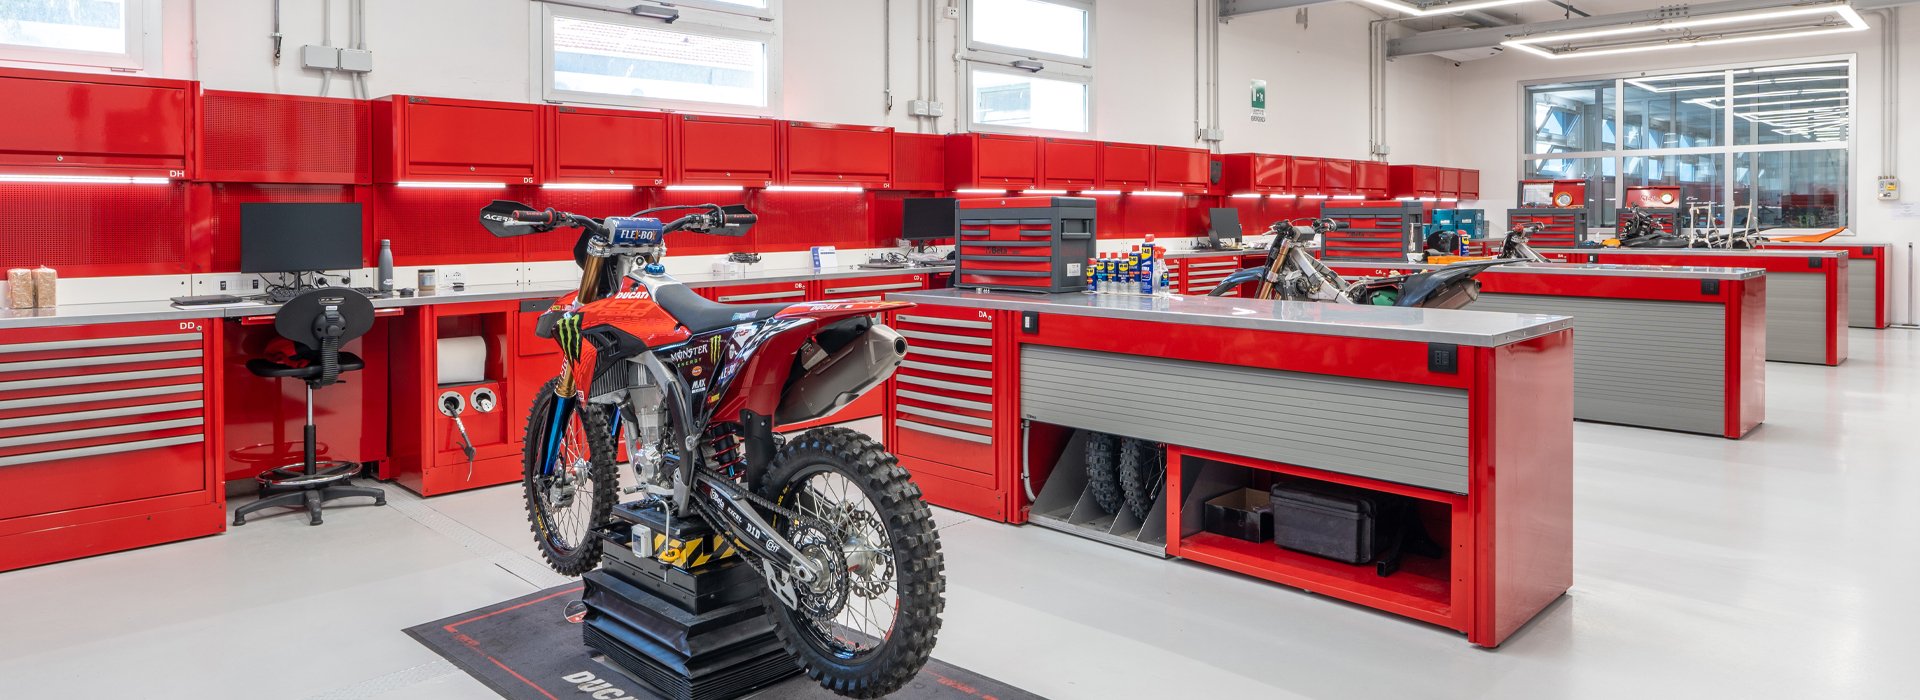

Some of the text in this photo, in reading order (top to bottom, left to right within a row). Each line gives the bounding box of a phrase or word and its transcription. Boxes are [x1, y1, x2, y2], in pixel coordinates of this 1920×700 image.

[169, 169, 185, 178] DH
[620, 229, 657, 241] FLEX-BOX
[614, 291, 650, 300] DUCATI
[978, 310, 987, 318] DA
[179, 321, 195, 330] DD
[670, 343, 708, 362] MONSTER
